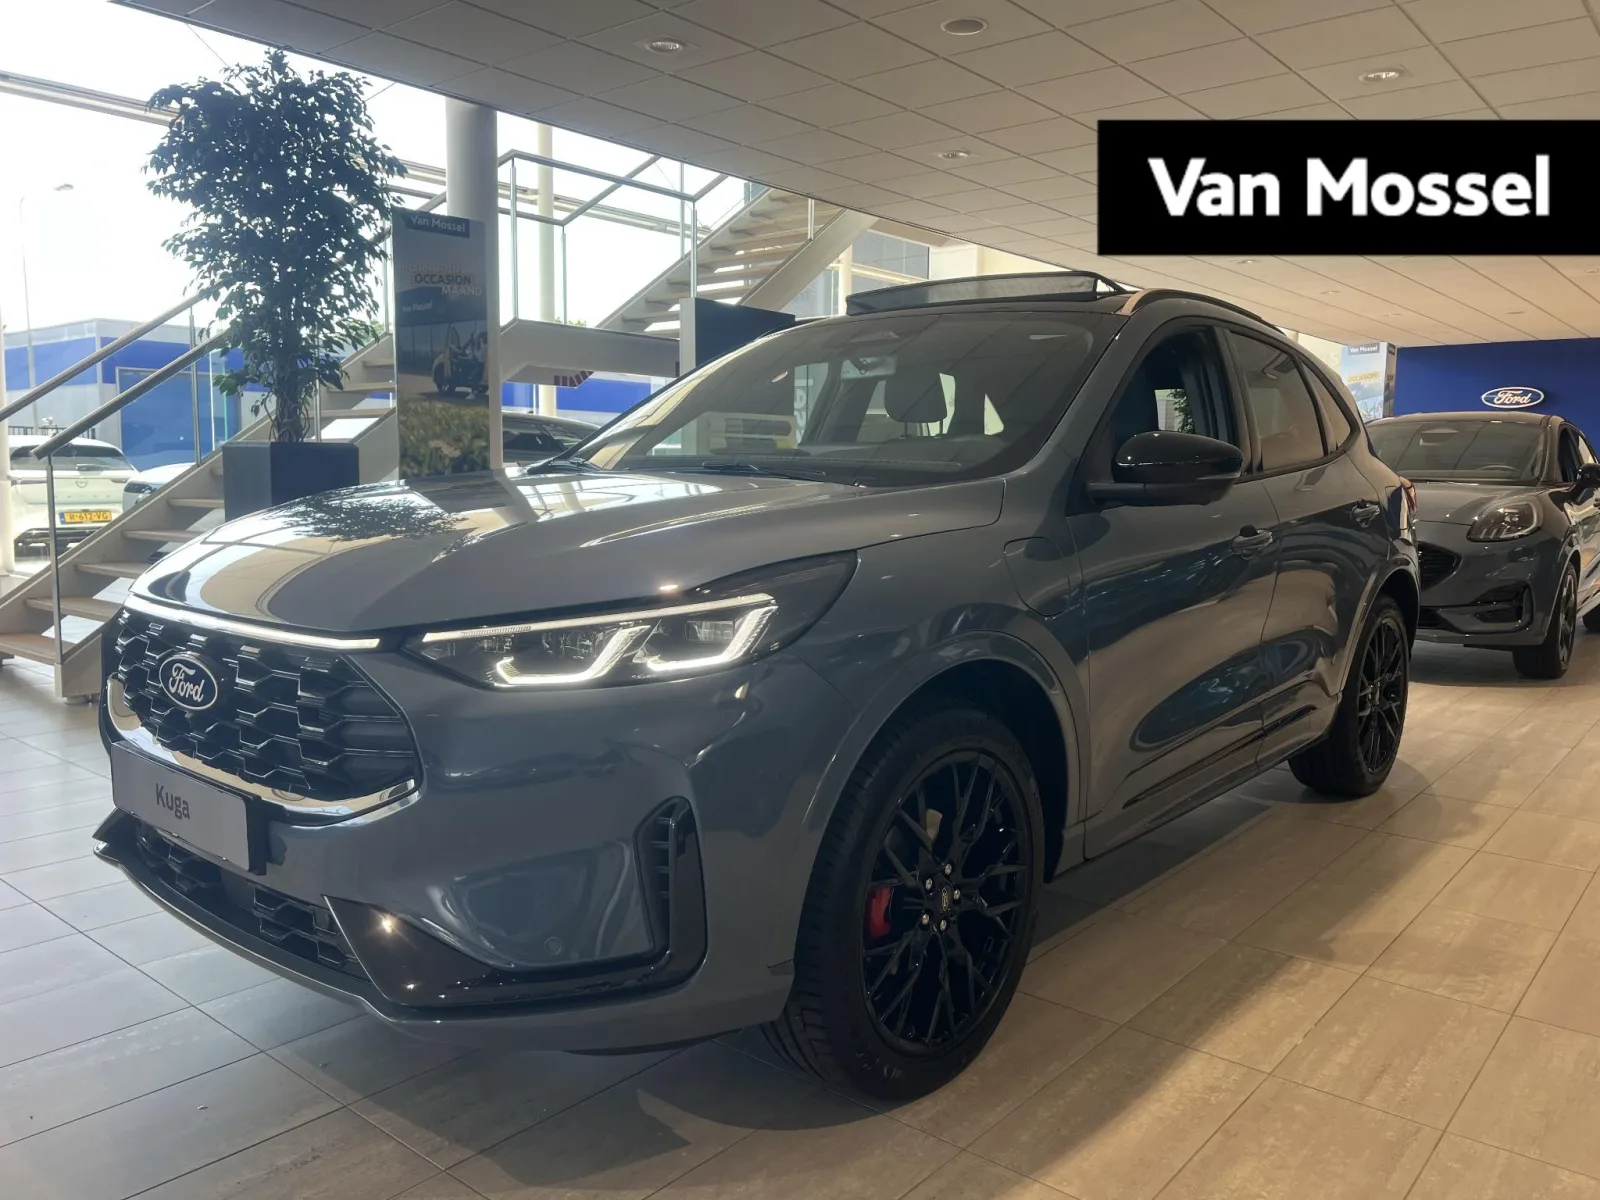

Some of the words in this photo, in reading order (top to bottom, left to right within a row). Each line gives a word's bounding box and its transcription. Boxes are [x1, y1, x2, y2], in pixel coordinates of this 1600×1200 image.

[410, 215, 429, 226] Van
[431, 218, 466, 233] Mossel
[413, 273, 471, 285] OCCASION
[441, 285, 482, 297] MAAND
[1493, 390, 1533, 405] Ford
[168, 662, 205, 702] Ford
[155, 782, 190, 820] Kuga
